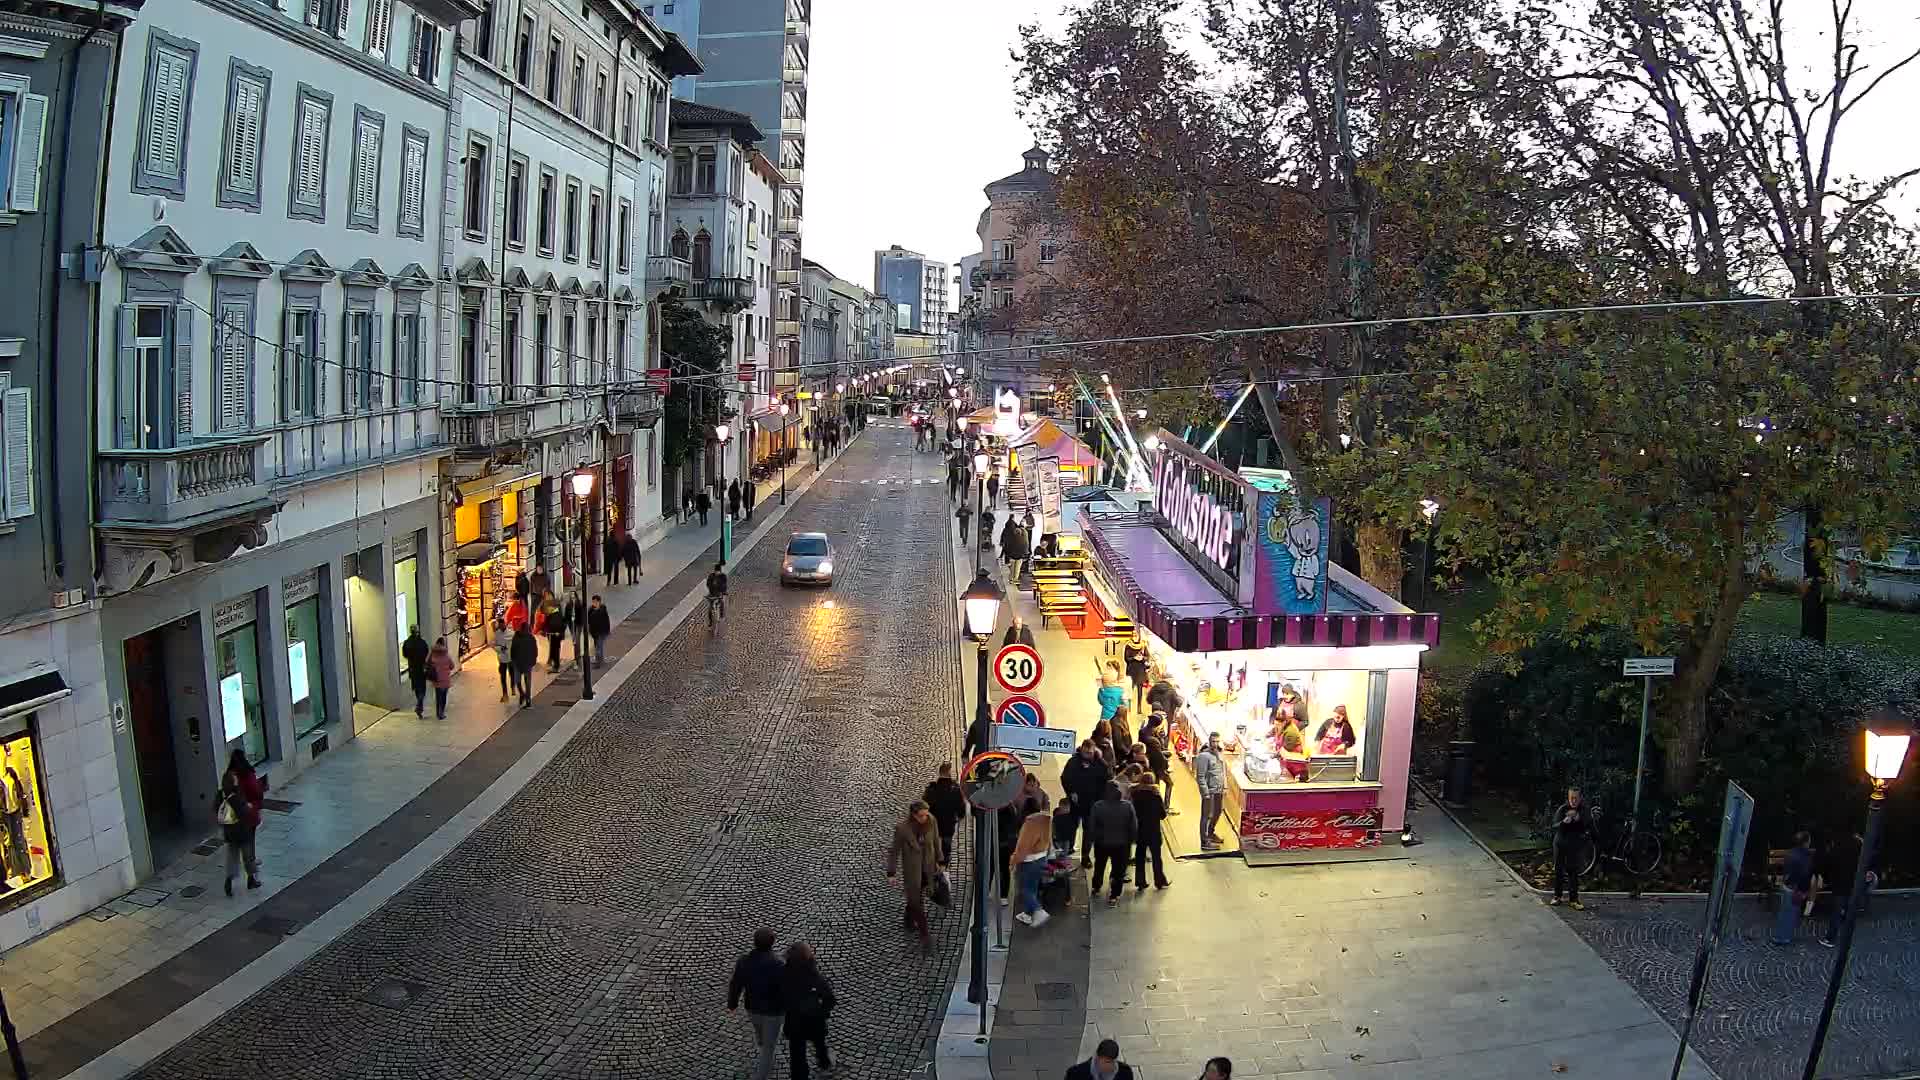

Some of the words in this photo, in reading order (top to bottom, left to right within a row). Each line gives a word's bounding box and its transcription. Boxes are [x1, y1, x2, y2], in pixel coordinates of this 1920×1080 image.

[1162, 455, 1233, 570] Golosone
[1006, 658, 1032, 680] 30
[1038, 737, 1069, 749] Dante
